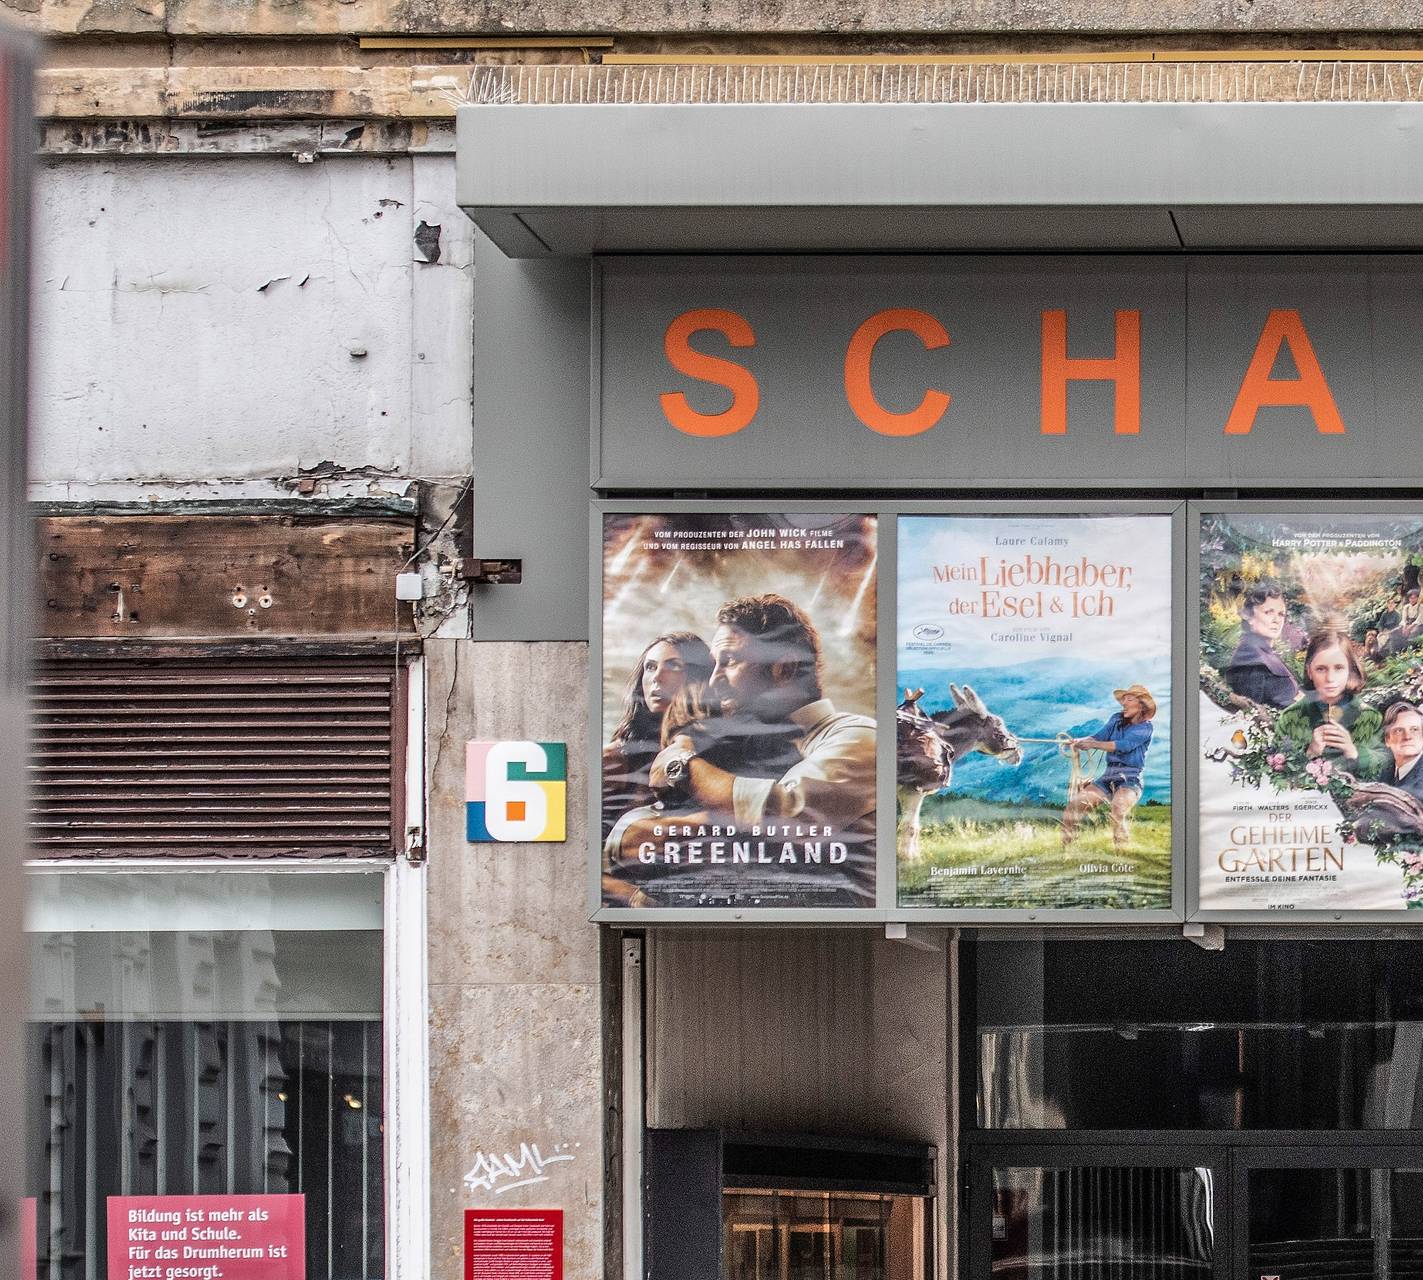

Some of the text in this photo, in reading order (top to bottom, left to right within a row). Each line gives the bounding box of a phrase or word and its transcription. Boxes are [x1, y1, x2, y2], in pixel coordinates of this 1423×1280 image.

[728, 530, 744, 538] DER
[746, 529, 776, 538] JOHN
[779, 528, 807, 538] WICK
[680, 542, 721, 550] REGISSEUR
[723, 542, 739, 550] VON
[741, 540, 776, 550] ANGEL
[780, 540, 801, 549] HAS
[805, 539, 844, 549] FALLEN
[995, 537, 1069, 547] Laure Calamy
[1272, 539, 1302, 548] HARRY
[1303, 539, 1337, 547] POTTER
[1345, 539, 1402, 547] PADDINGTON
[933, 555, 1132, 591] Mein Liebhaber,
[949, 590, 1113, 618] der Esel & Ich
[990, 632, 1073, 643] Caroline Vignal
[485, 741, 547, 841] 6
[1269, 813, 1292, 823] DER
[653, 825, 833, 837] GERARD BUTLER
[1230, 825, 1332, 846] GEHEIME
[638, 841, 849, 864] GREENLAND
[1218, 847, 1344, 873] GARTEN
[930, 866, 977, 876] Benjamin
[980, 865, 1027, 875] Lavernhe
[1079, 863, 1108, 873] Olivia
[1225, 875, 1270, 883] ENTFESSLE
[1298, 874, 1337, 882] FANTASIE
[128, 1207, 269, 1224] Bildung ist mehr als
[128, 1226, 241, 1241] Kita und Schule.
[128, 1245, 287, 1260] Für das Drumherum ist
[128, 1264, 223, 1280] jetzt gesorgt.
